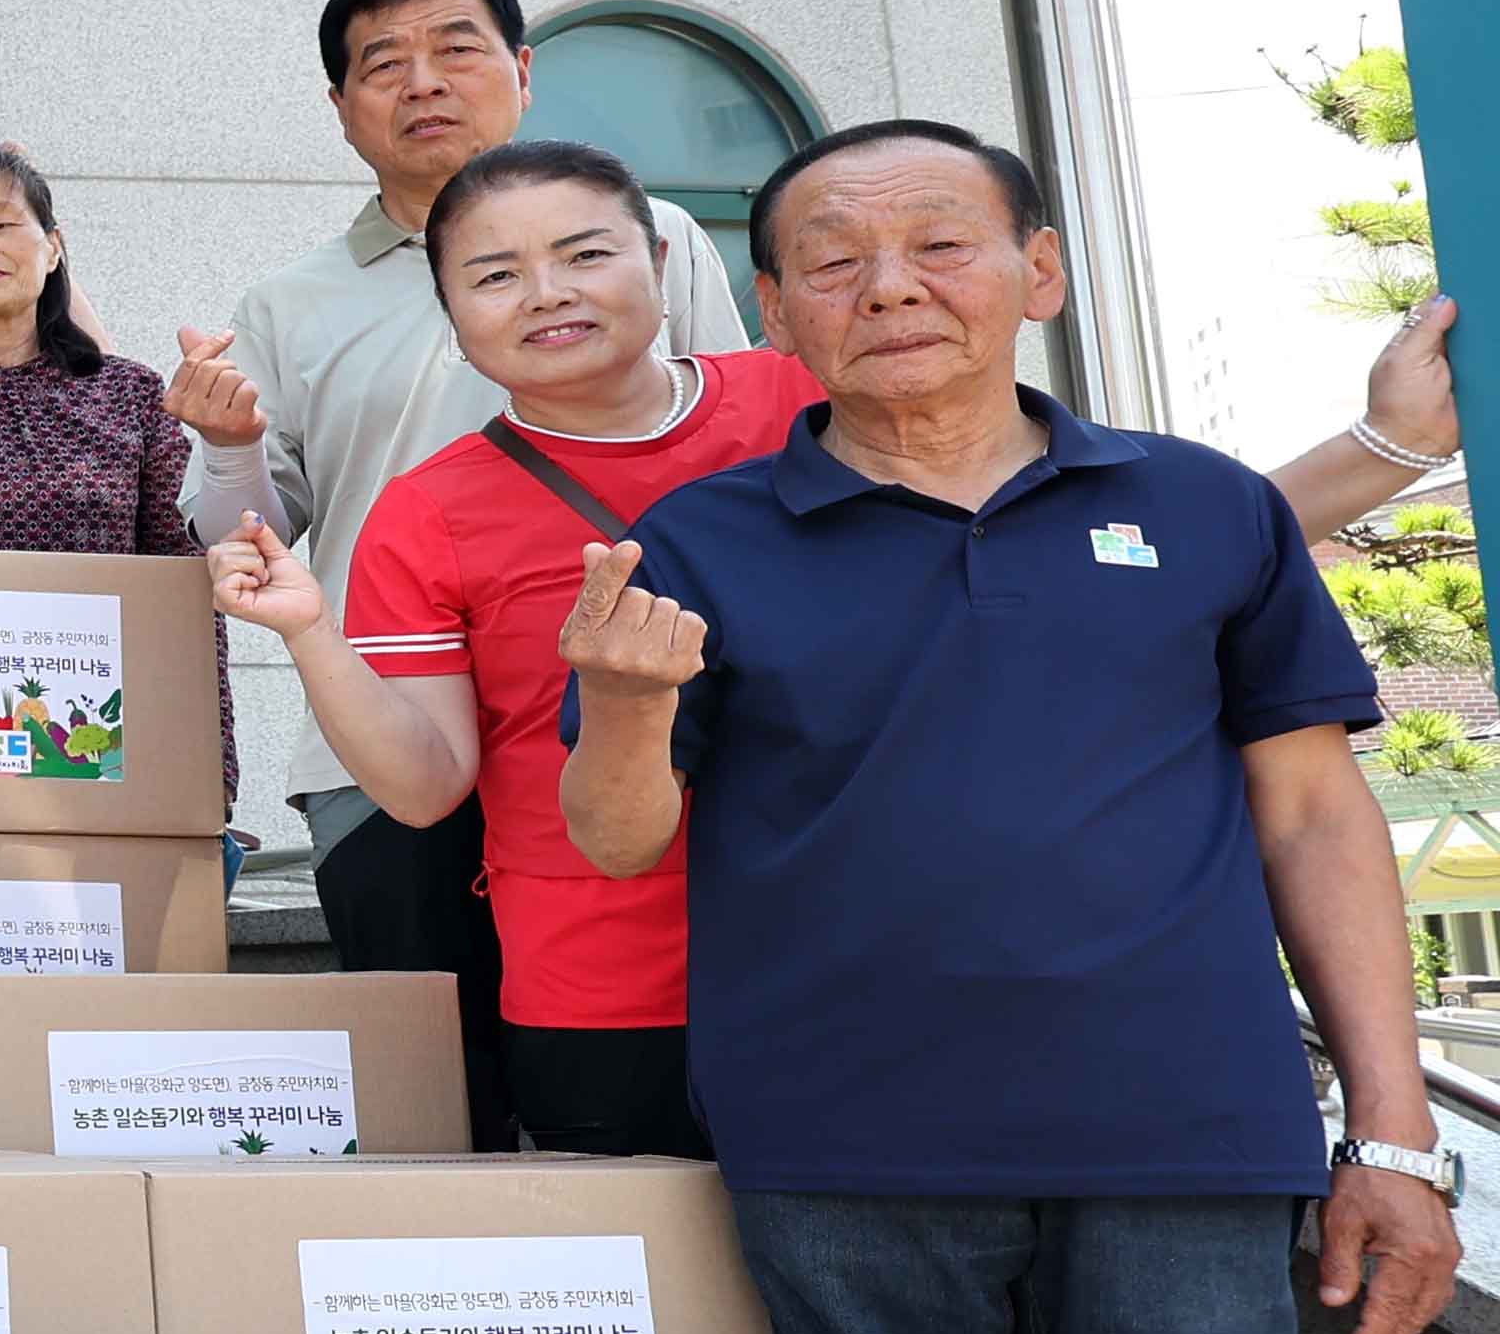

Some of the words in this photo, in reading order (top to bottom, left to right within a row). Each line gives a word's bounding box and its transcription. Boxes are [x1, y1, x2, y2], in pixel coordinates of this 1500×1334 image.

[29, 657, 77, 675] 꾸러미
[80, 659, 112, 677] 나눔
[71, 1108, 110, 1129] 농촌
[113, 1106, 204, 1129] 일손돕기와
[207, 1106, 245, 1128] 행복
[247, 1105, 304, 1127] 꾸러미
[306, 1105, 344, 1127] 나눔
[324, 1294, 382, 1315] 함께하는
[517, 1291, 560, 1310] 금창동
[562, 1289, 634, 1308] 주민자치회
